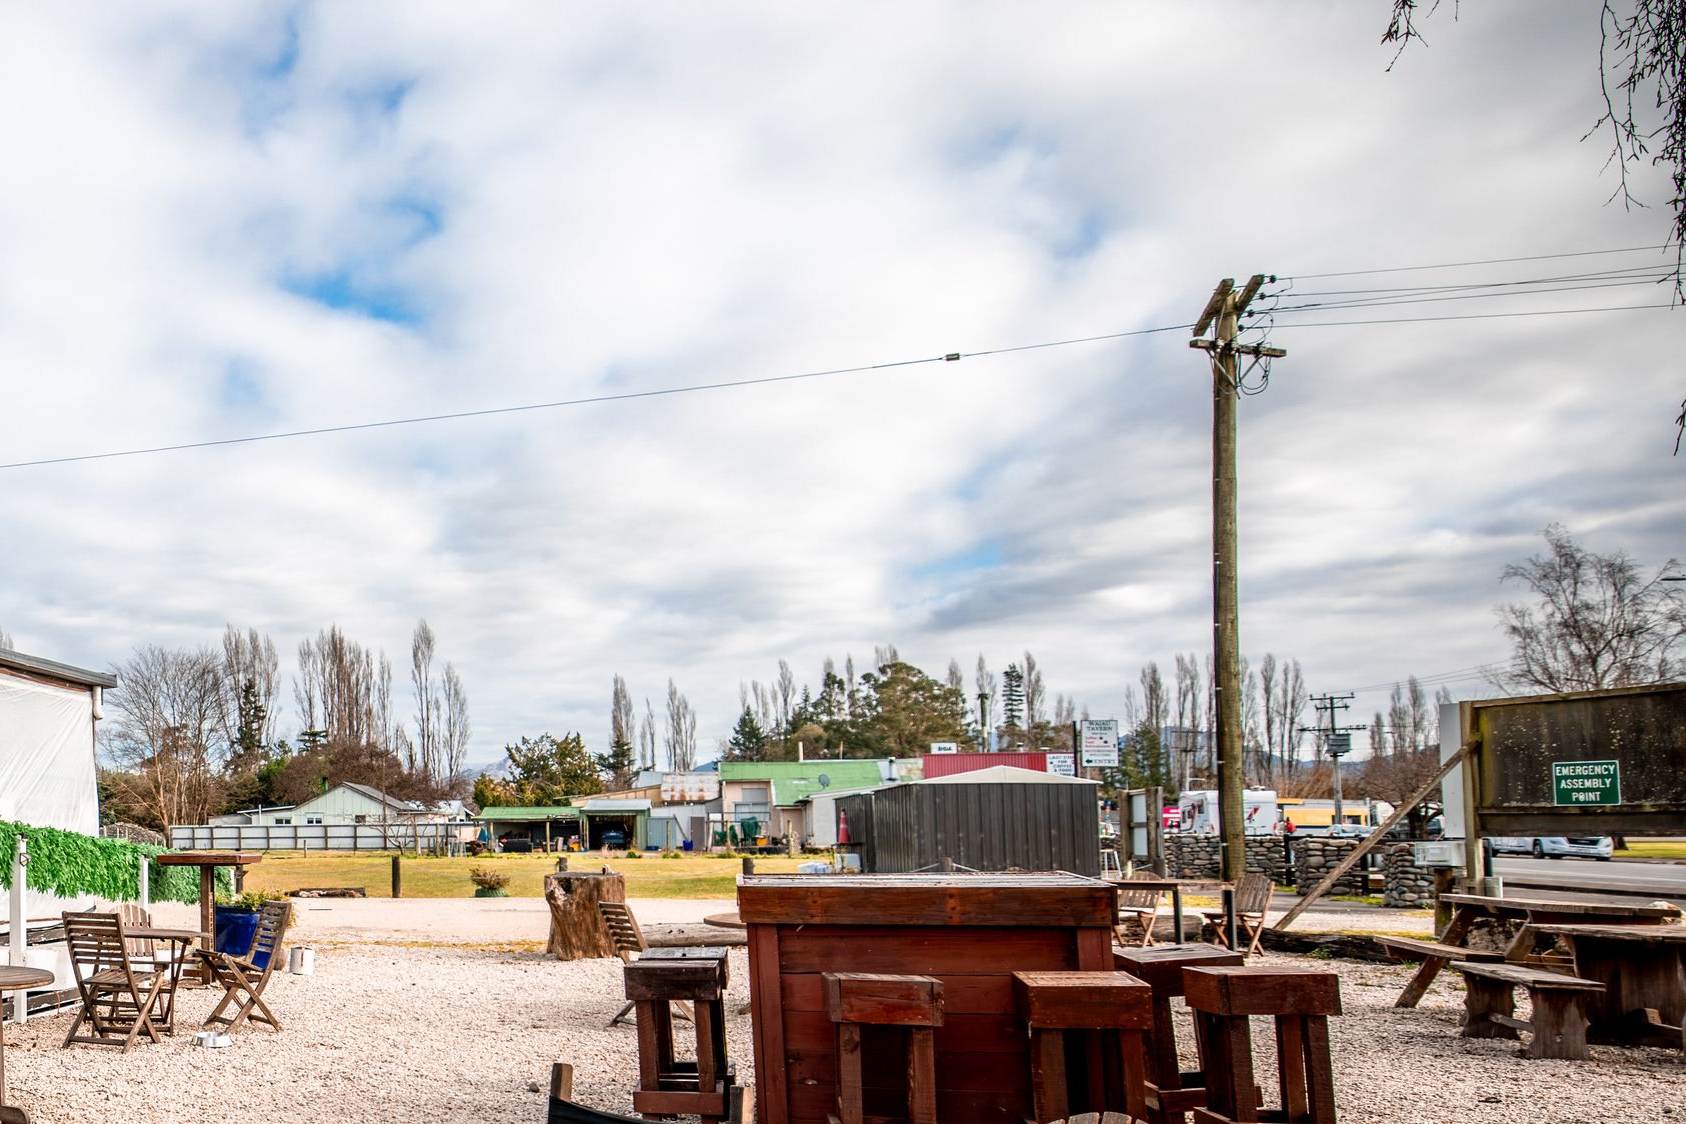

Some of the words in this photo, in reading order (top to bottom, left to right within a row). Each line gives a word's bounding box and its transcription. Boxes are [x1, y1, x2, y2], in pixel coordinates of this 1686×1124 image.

[1555, 764, 1616, 776] EMERGENCY
[1560, 778, 1612, 789] ASSEMBLY
[1571, 791, 1601, 802] POINT
